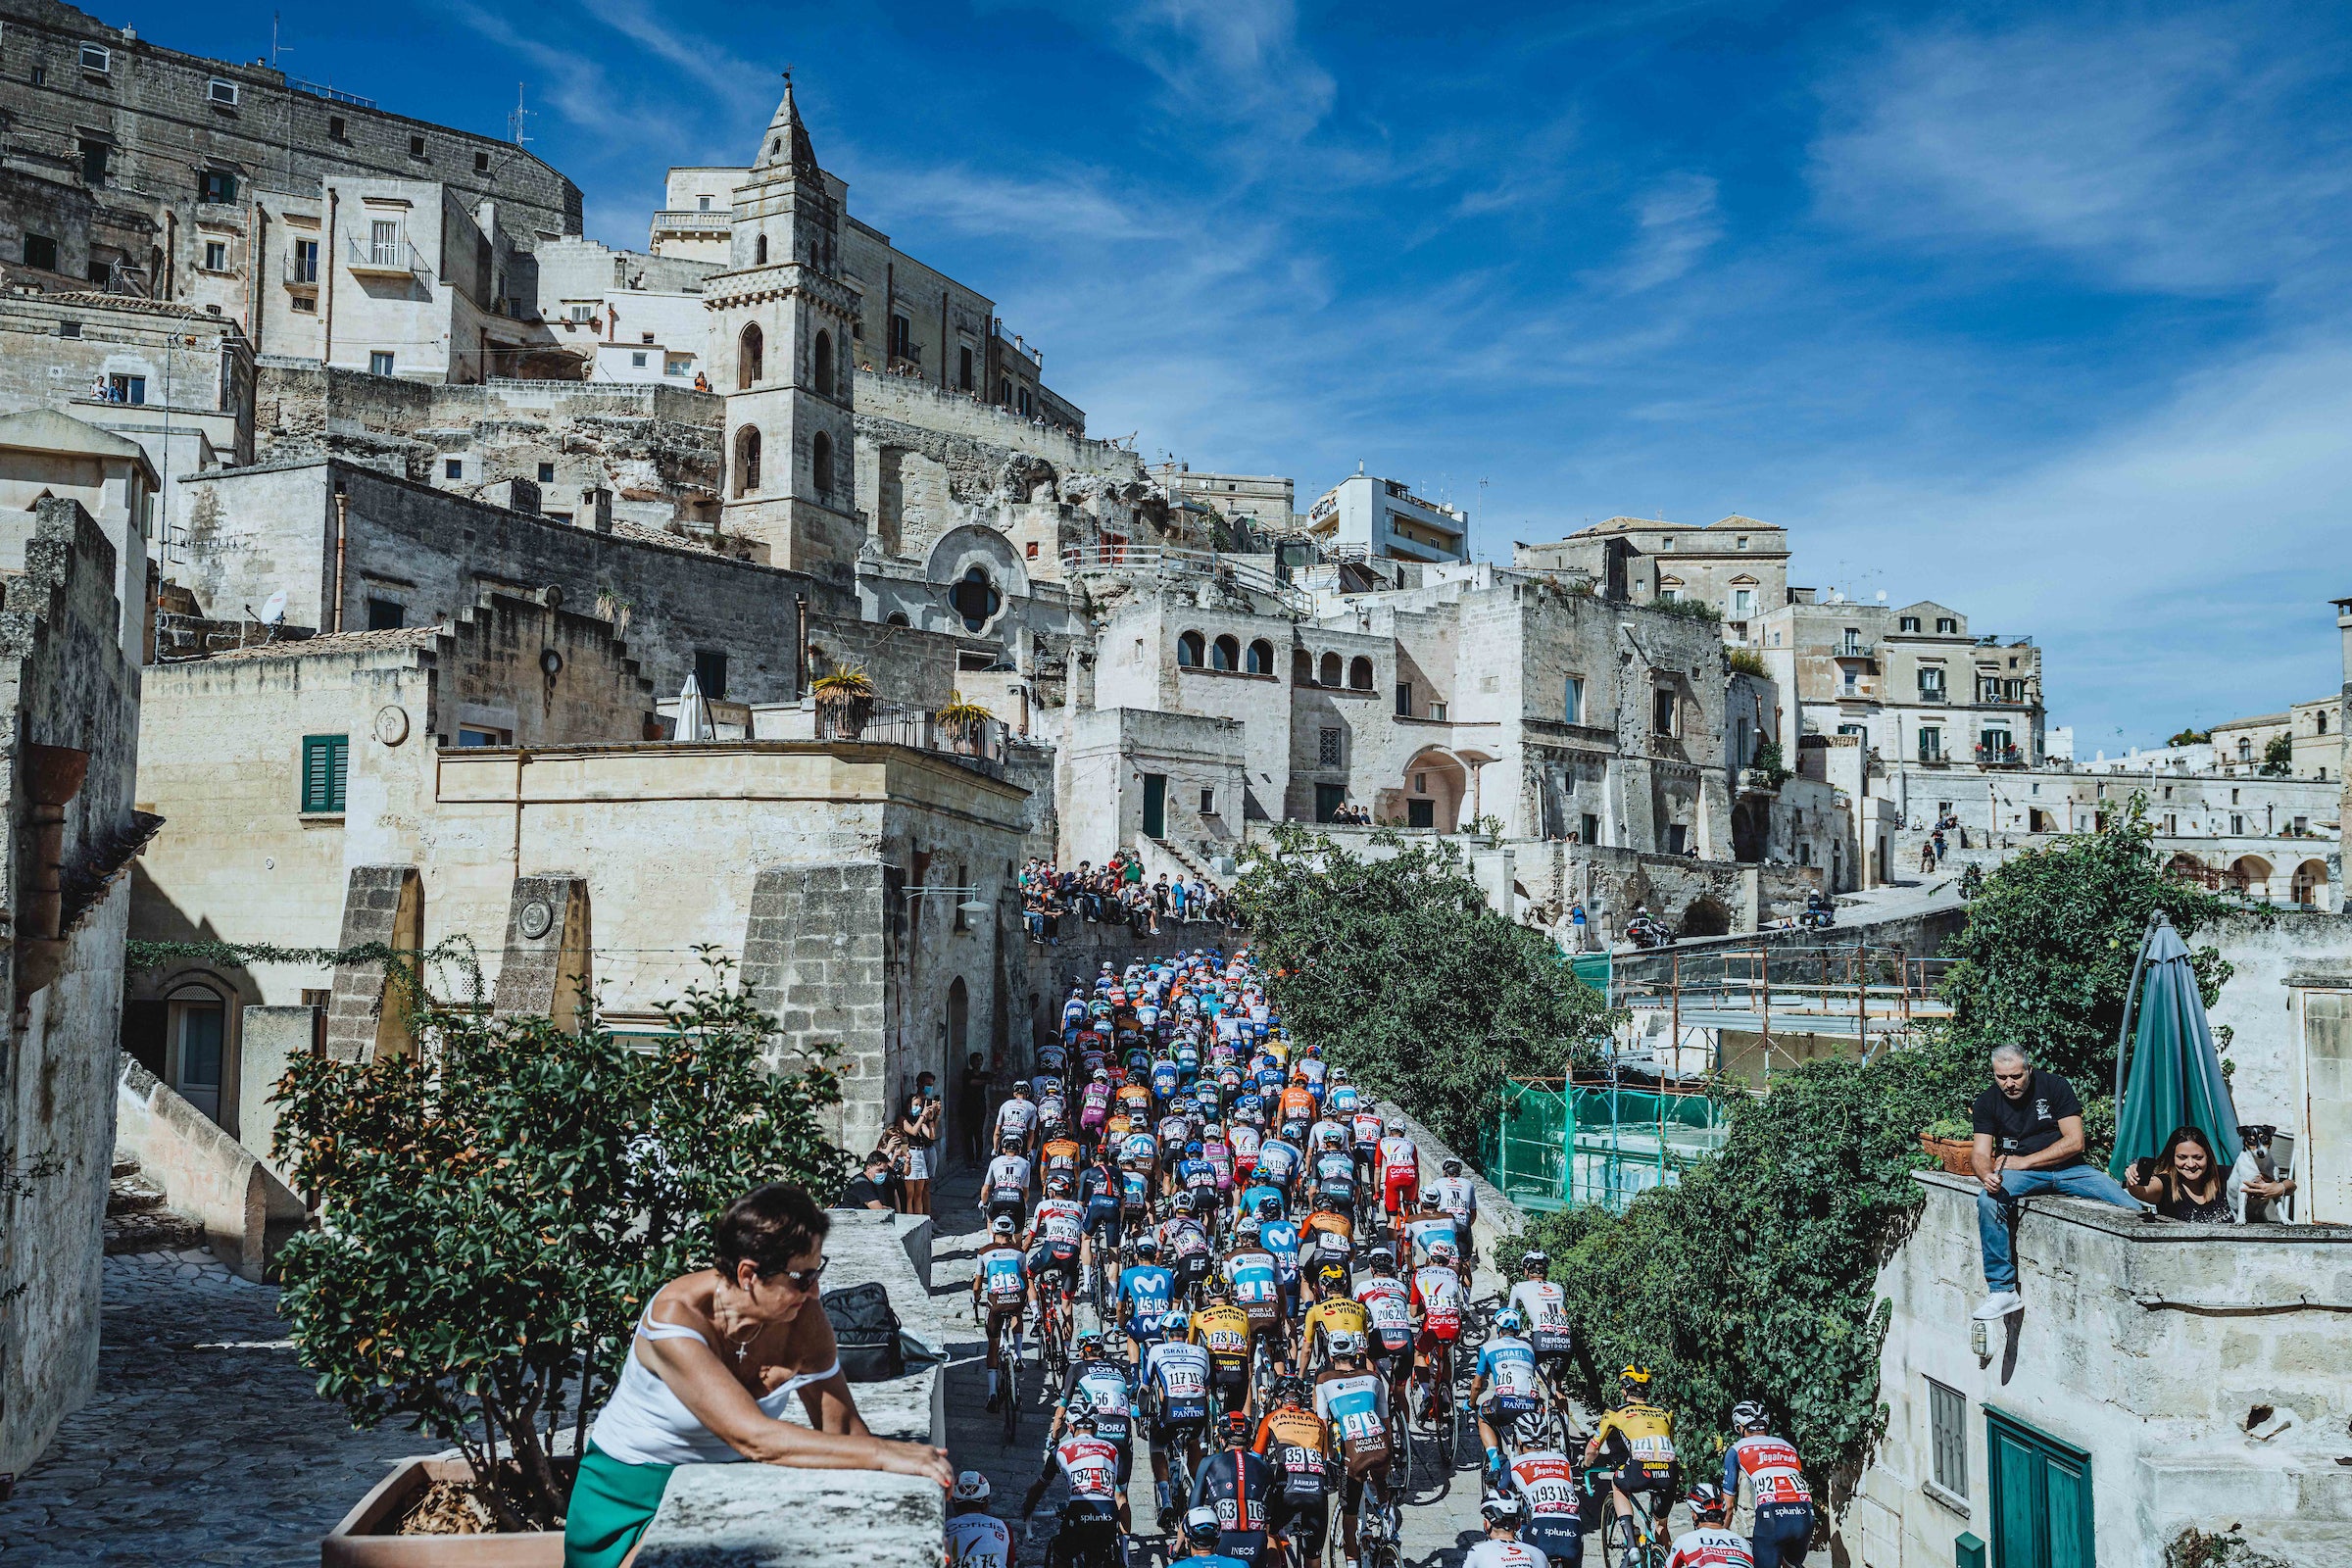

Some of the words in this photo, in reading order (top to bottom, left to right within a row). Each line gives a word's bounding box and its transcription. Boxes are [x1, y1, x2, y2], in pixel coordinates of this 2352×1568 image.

[1288, 1092, 1309, 1101] CCC
[1190, 1258, 1205, 1271] EF
[995, 1275, 1002, 1287] 5
[1010, 1273, 1017, 1285] 5
[1267, 1281, 1274, 1293] 4
[1323, 1301, 1360, 1311] JUMBO
[1338, 1307, 1363, 1318] VISMA
[1378, 1309, 1394, 1321] 206
[1428, 1316, 1459, 1325] Cofidis
[1210, 1332, 1228, 1344] 178
[1387, 1331, 1403, 1340] UAE
[1541, 1336, 1570, 1345] RENSON
[1495, 1350, 1525, 1359] ISRAEL
[1088, 1366, 1123, 1376] BORA
[1170, 1372, 1186, 1386] 117
[1095, 1392, 1108, 1406] 56
[1503, 1401, 1536, 1410] FANTINI
[1172, 1410, 1205, 1419] FANTINI
[1272, 1413, 1324, 1426] BAHRAIN
[1367, 1410, 1377, 1427] 6
[1097, 1423, 1127, 1433] BORA
[1348, 1415, 1357, 1431] 6
[1355, 1440, 1374, 1448] AG2R
[1373, 1437, 1383, 1446] LA
[1355, 1443, 1385, 1453] MONDIALE
[1286, 1448, 1302, 1463] 35
[1757, 1450, 1797, 1465] Segafredo
[1286, 1464, 1305, 1473] enel
[1652, 1470, 1671, 1479] VISMA
[1293, 1479, 1320, 1489] BAHRAIN
[1789, 1474, 1807, 1492] 19
[1249, 1502, 1264, 1520] 16
[1699, 1537, 1743, 1549] UAE
[1230, 1546, 1255, 1556] INEOS
[1702, 1547, 1745, 1559] Emirates
